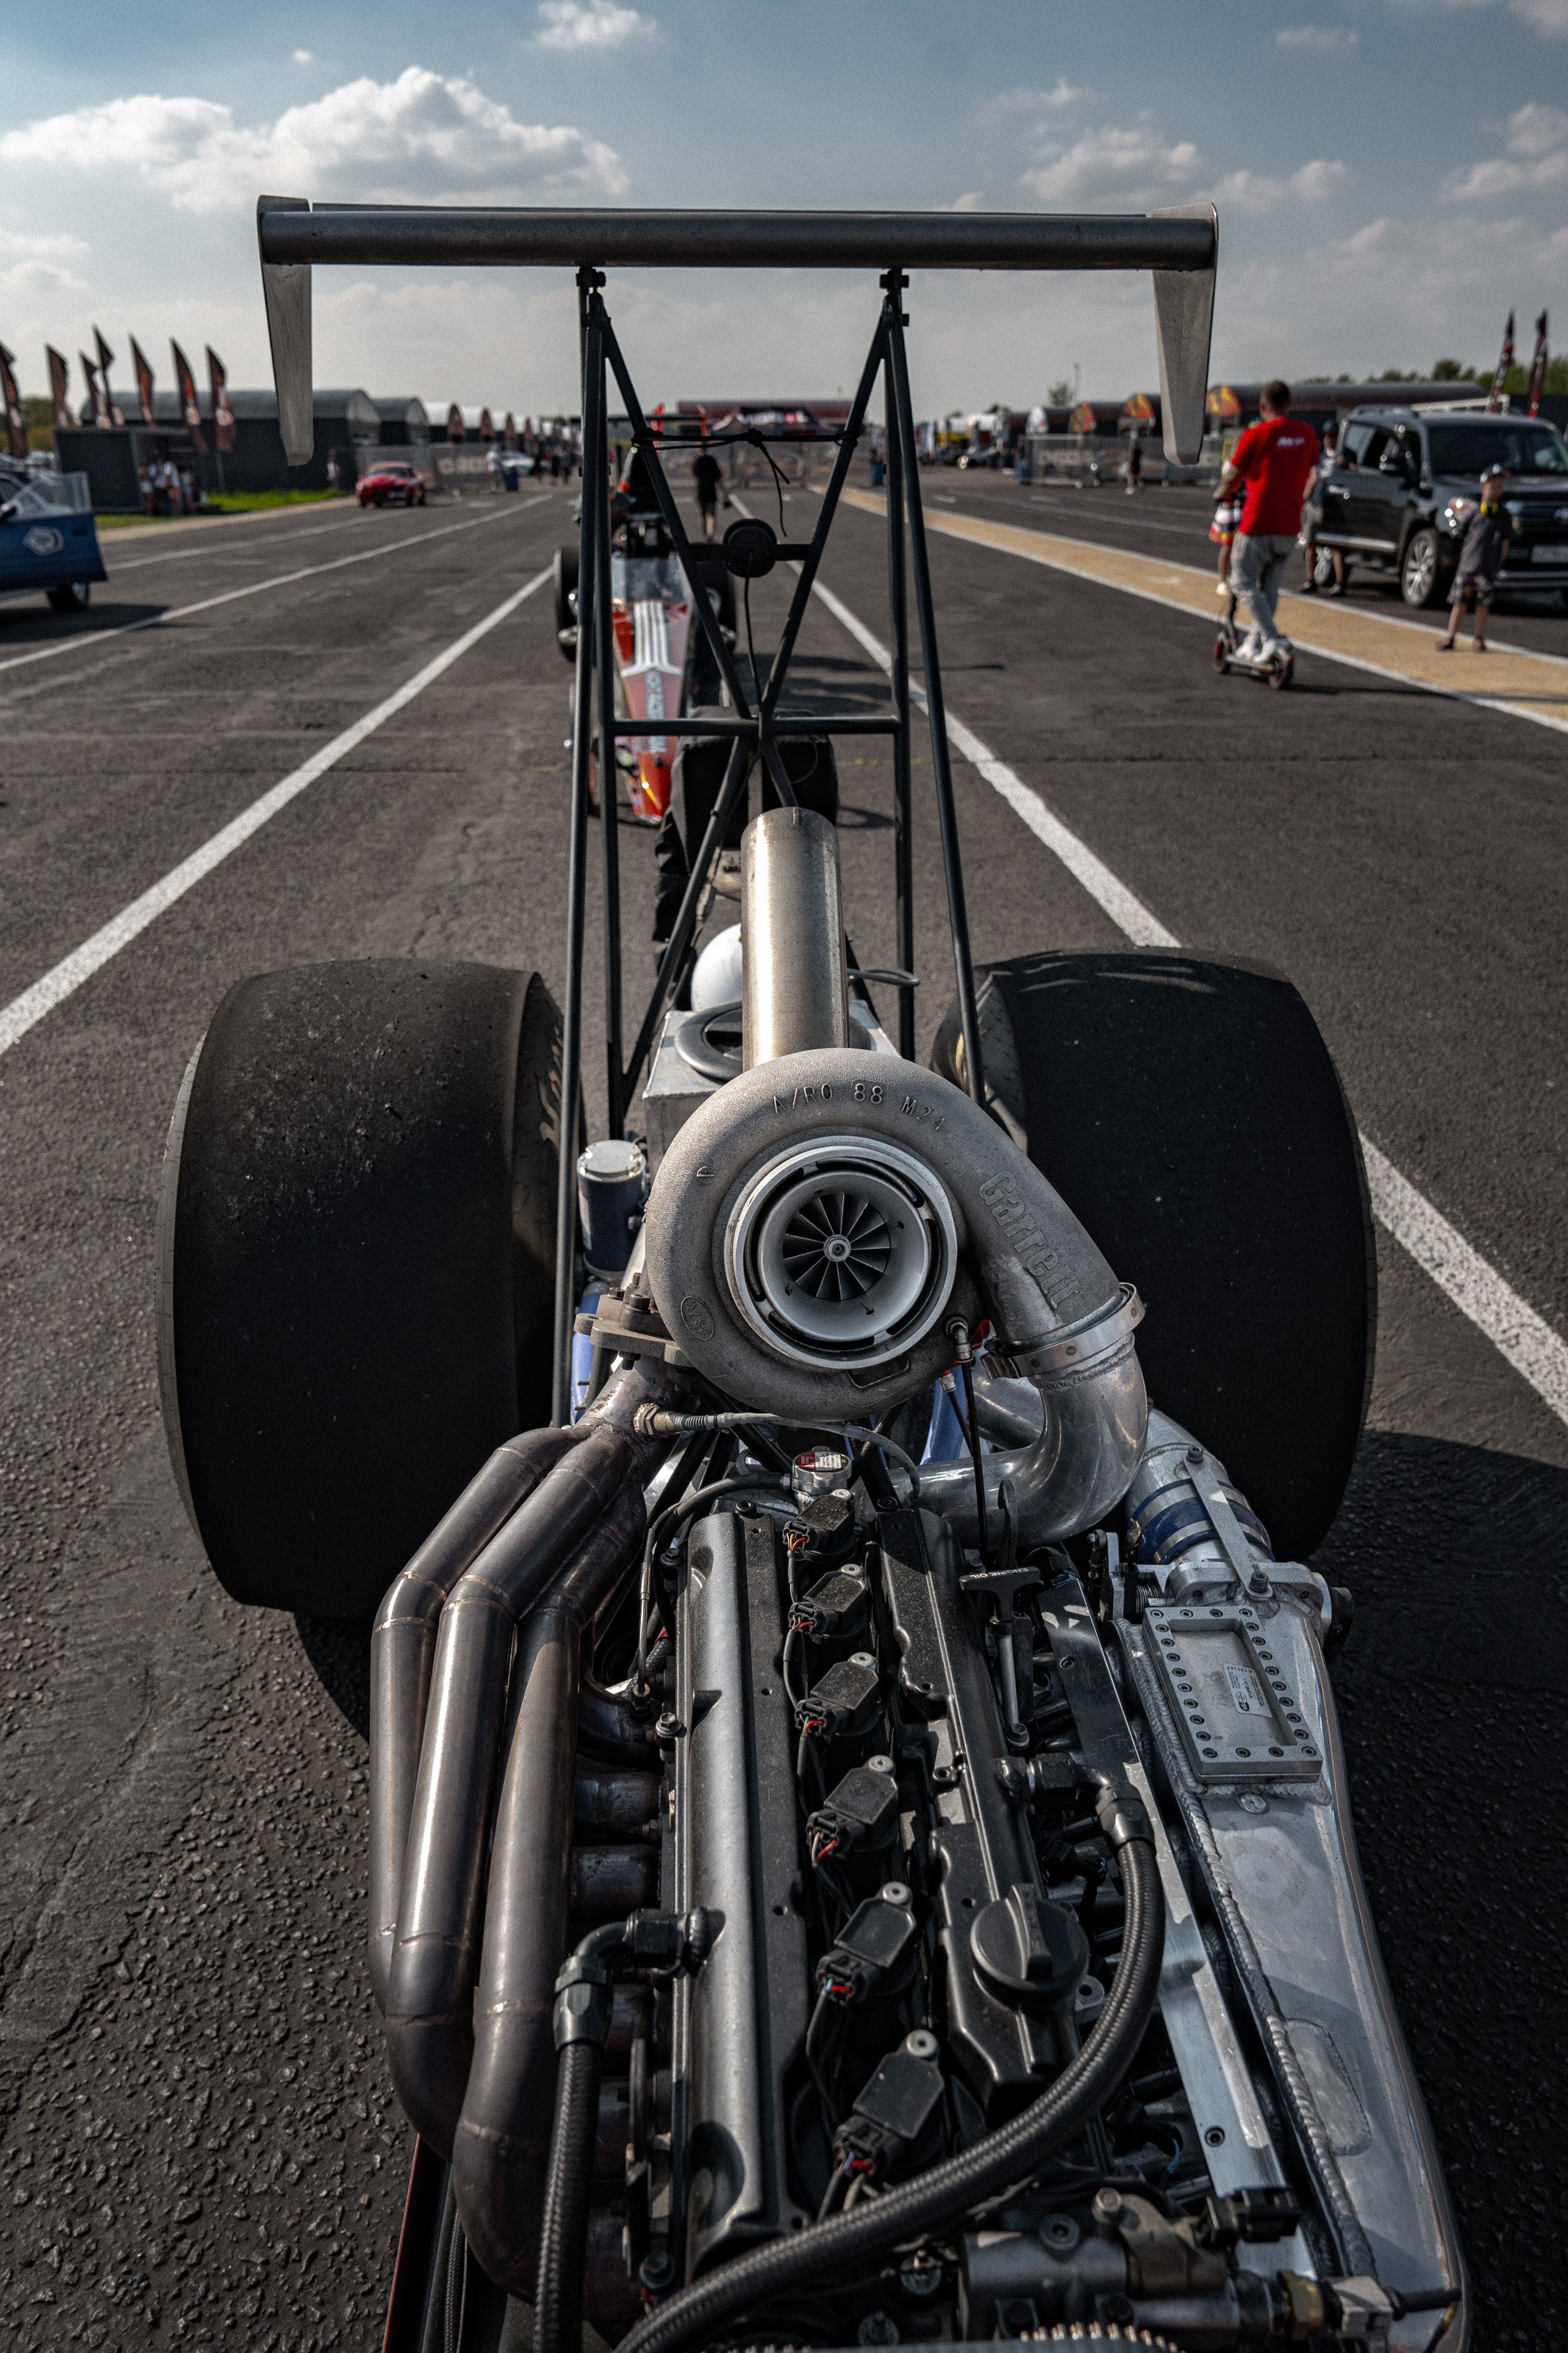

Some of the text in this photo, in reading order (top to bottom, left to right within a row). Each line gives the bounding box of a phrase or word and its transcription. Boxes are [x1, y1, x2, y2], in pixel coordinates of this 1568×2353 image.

[853, 1082, 884, 1104] 88
[900, 1096, 945, 1132] M24
[979, 1171, 1081, 1310] Garrett
[989, 1567, 1029, 1577] ENGINE
